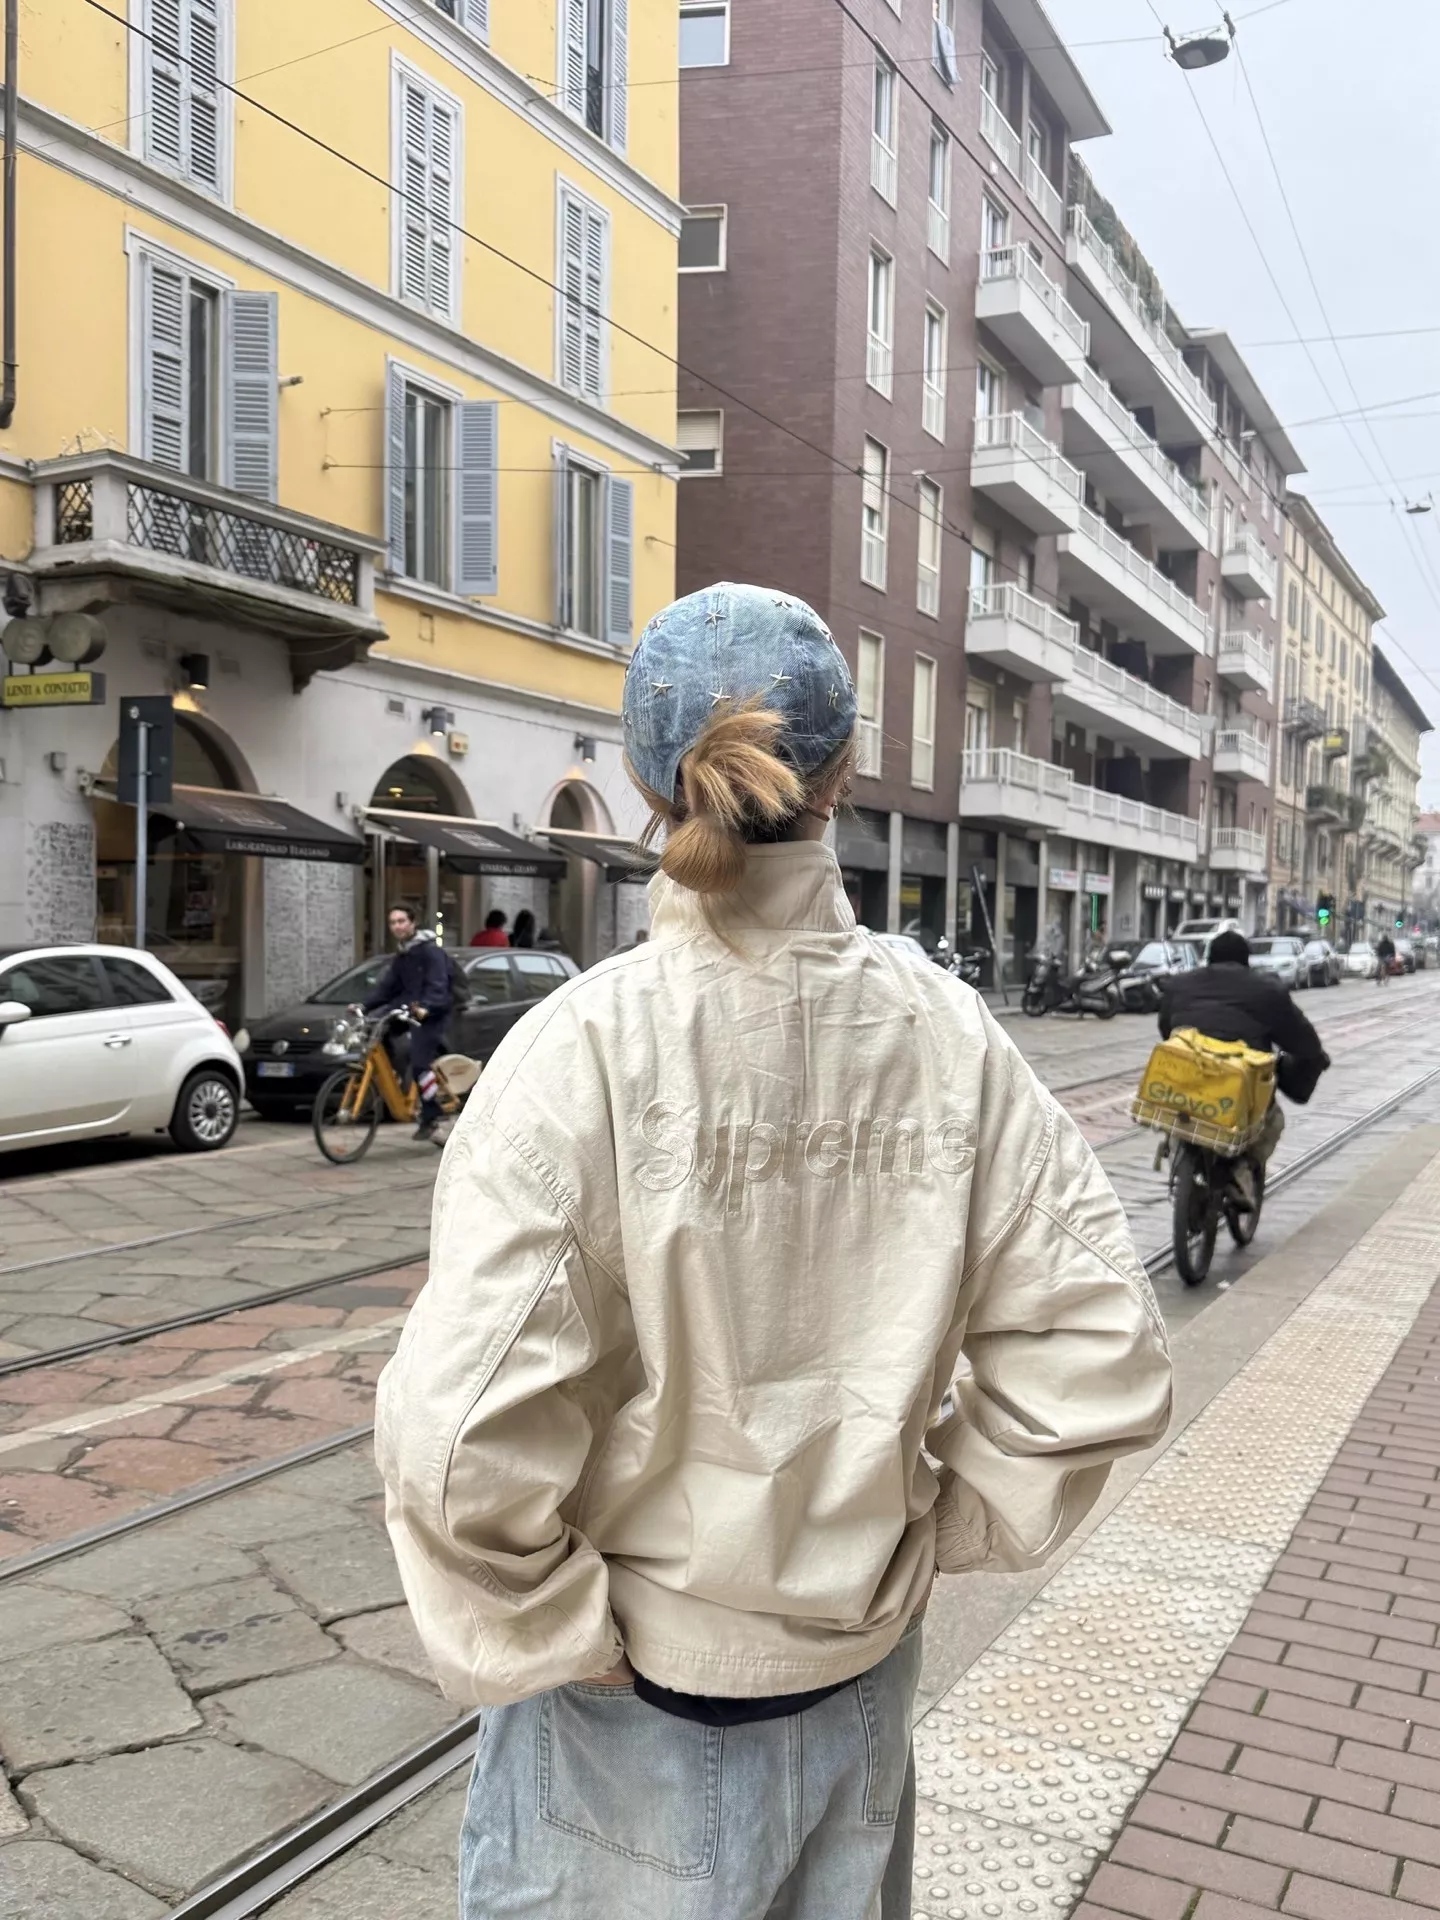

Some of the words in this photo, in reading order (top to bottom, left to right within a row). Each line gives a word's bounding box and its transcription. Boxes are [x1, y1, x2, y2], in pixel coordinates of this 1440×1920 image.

[7, 684, 32, 697] LENTI
[35, 683, 42, 696] A
[44, 681, 90, 696] CONTATTO
[1148, 1081, 1217, 1118] Glovo
[633, 1100, 978, 1213] Supreme
